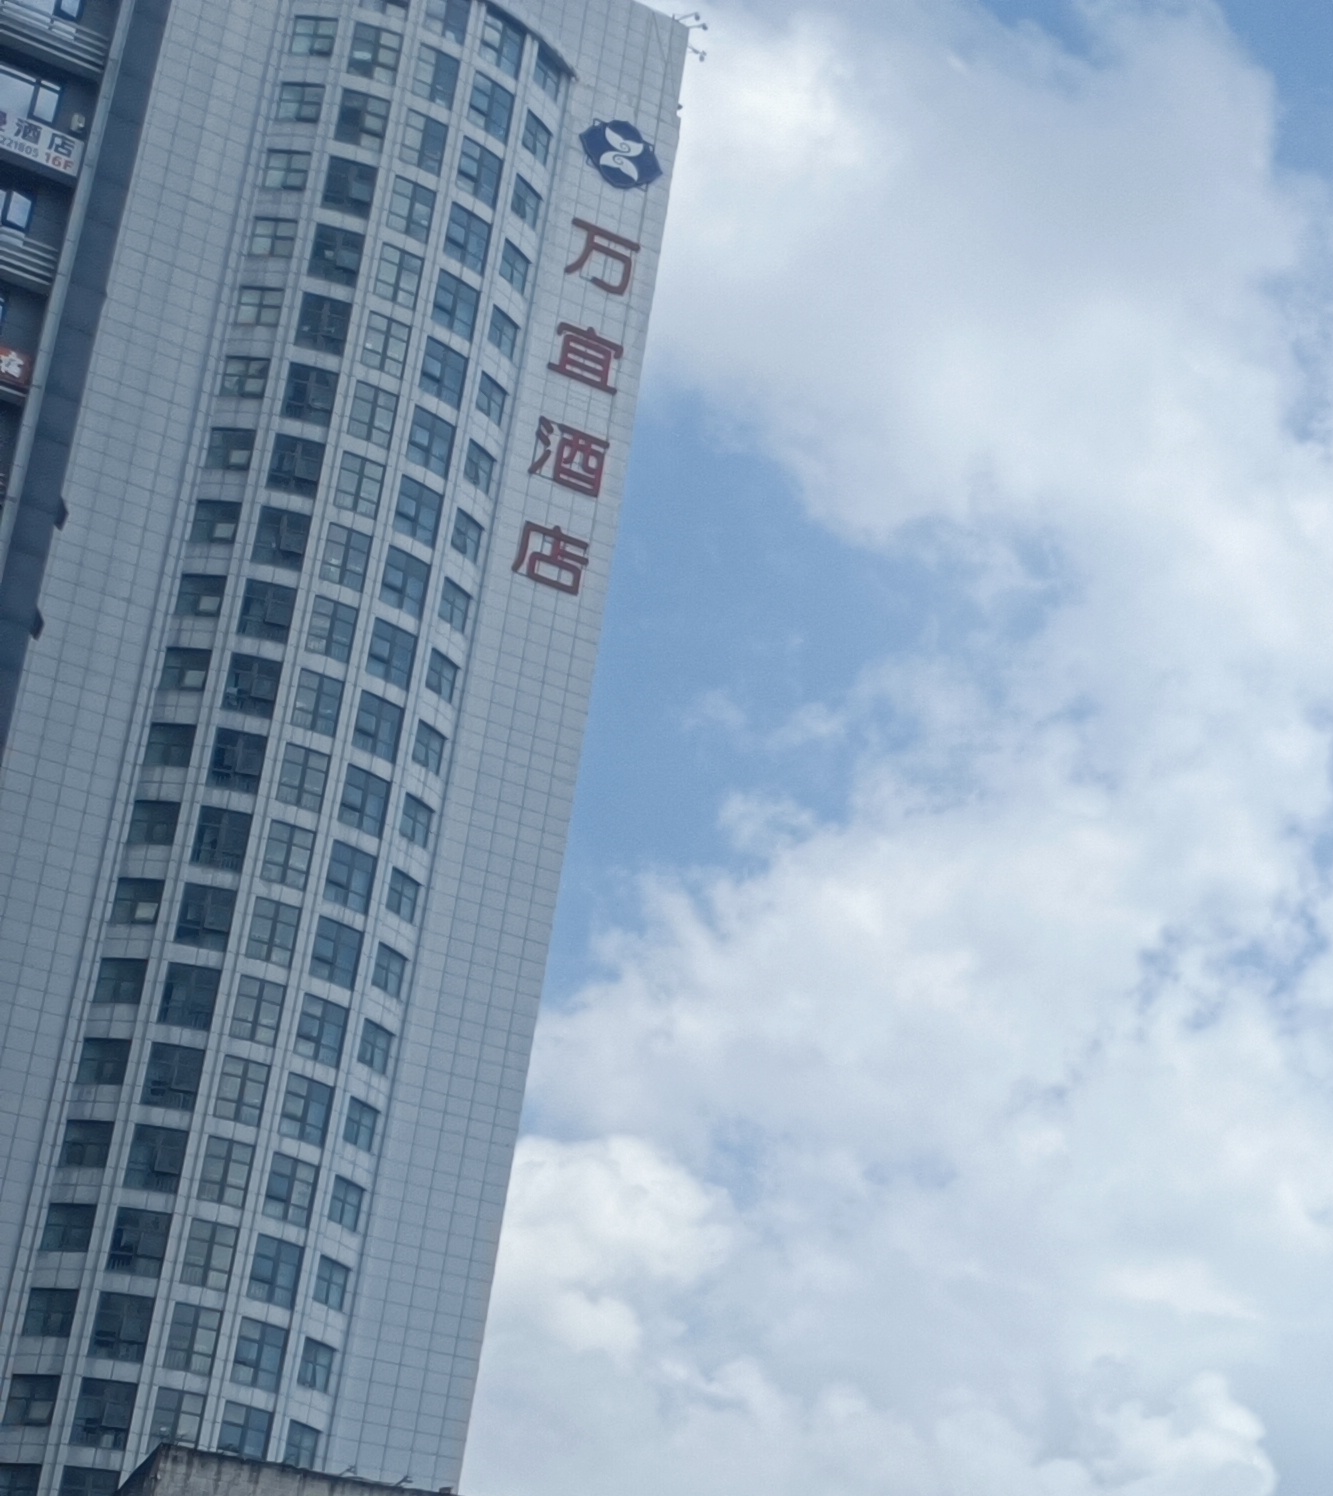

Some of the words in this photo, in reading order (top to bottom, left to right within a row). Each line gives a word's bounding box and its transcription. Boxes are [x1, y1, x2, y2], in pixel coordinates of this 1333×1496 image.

[44, 152, 74, 170] 16F
[511, 216, 641, 596] 万宜酒店
